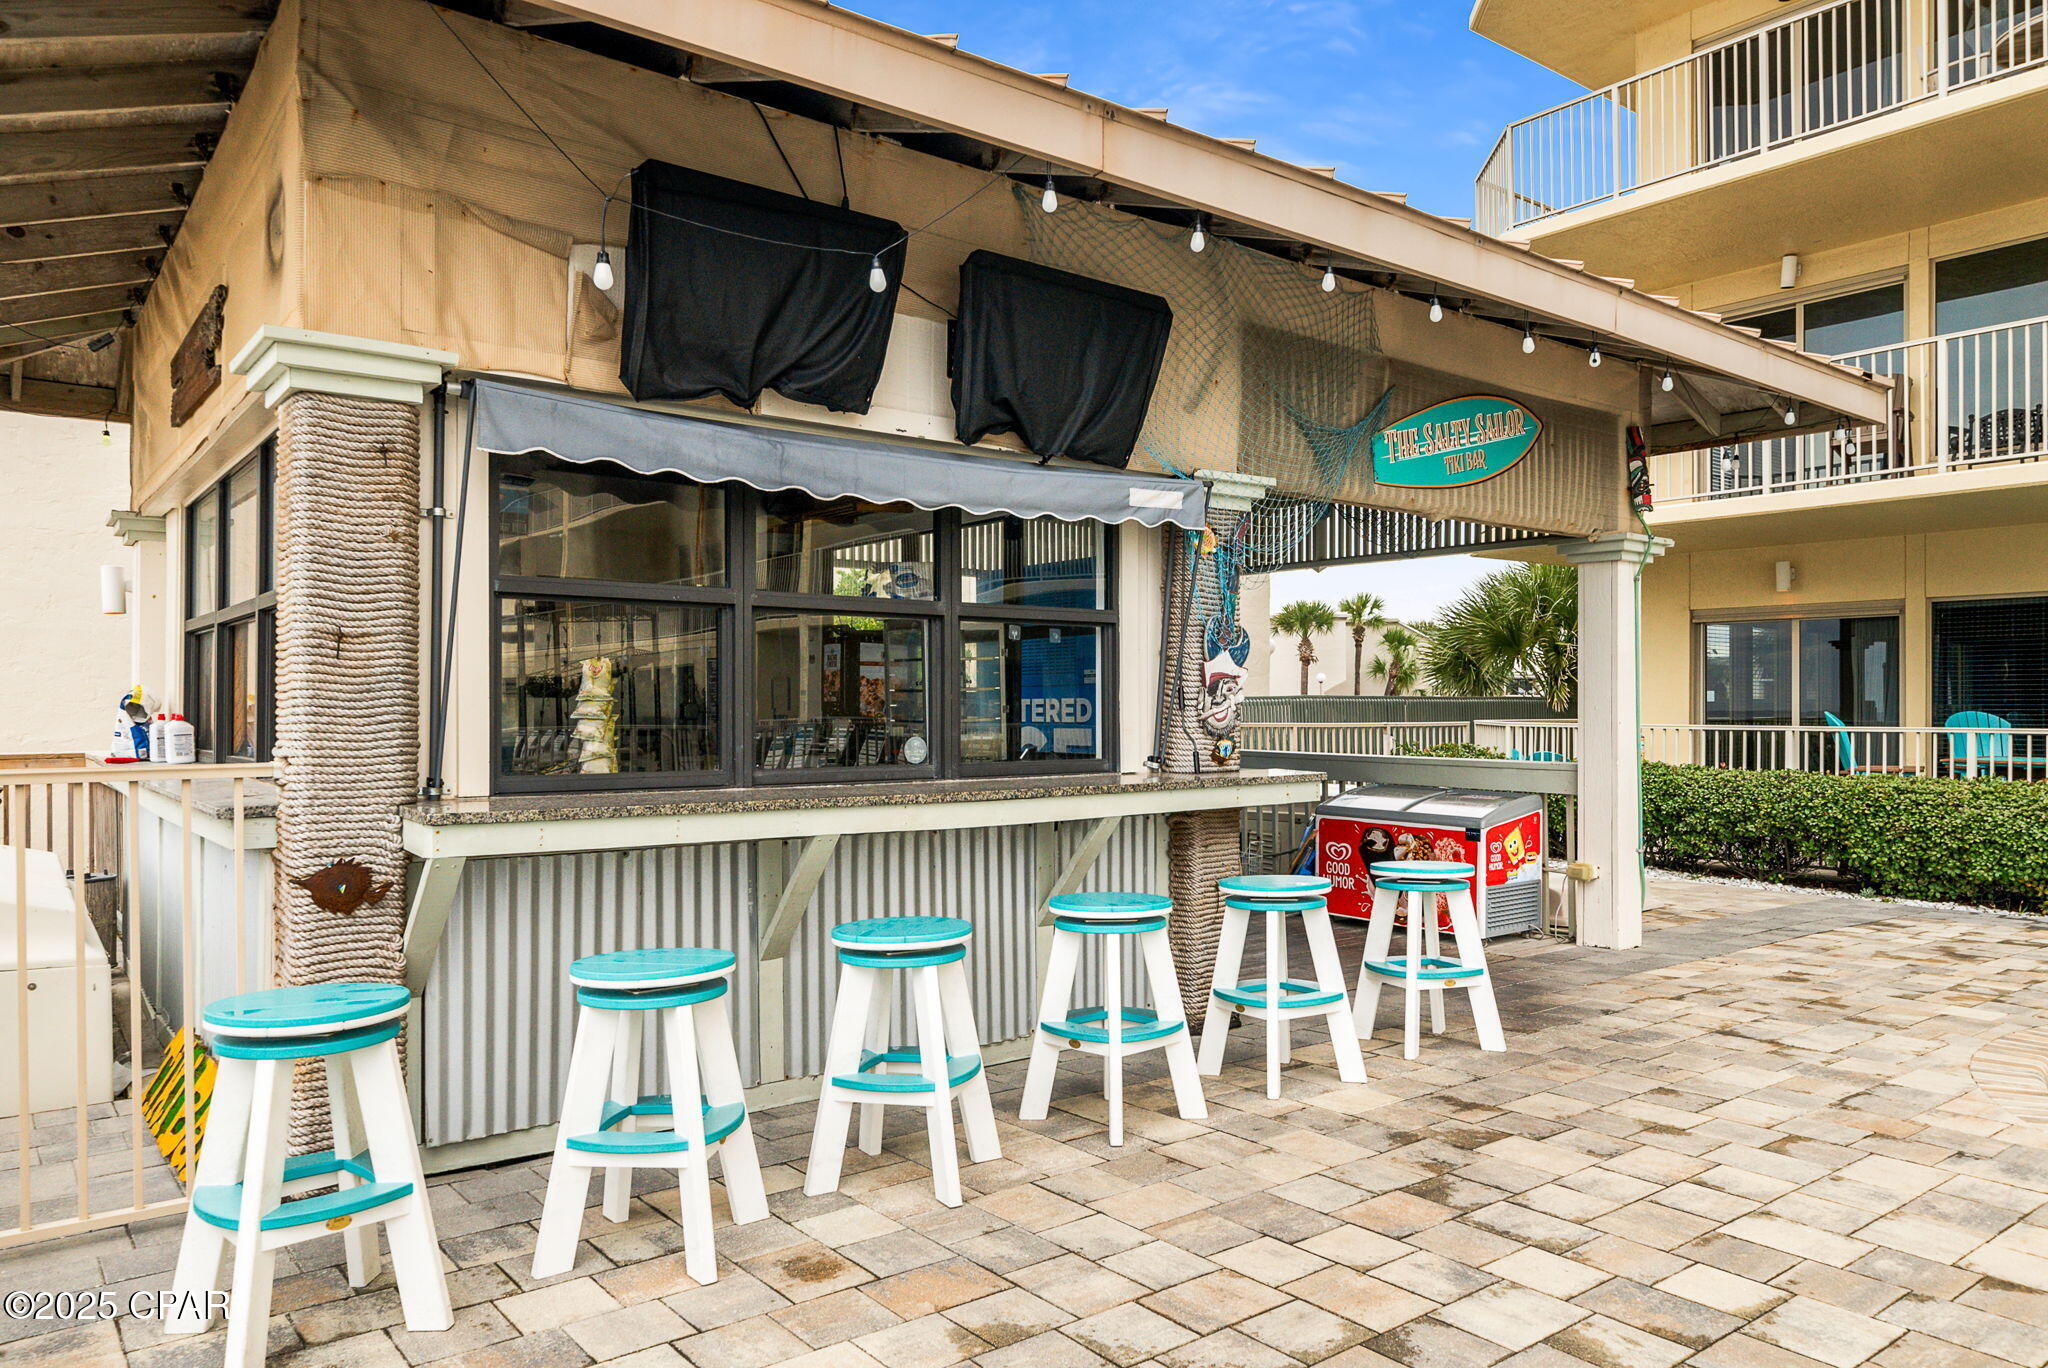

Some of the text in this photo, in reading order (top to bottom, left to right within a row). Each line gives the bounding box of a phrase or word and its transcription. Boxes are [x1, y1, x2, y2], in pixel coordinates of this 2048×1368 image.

[1384, 409, 1526, 463] THE SALTY SAILOR
[1444, 449, 1488, 475] TIKI BAR
[1325, 860, 1351, 875] GOOD
[1323, 874, 1355, 890] UMOR
